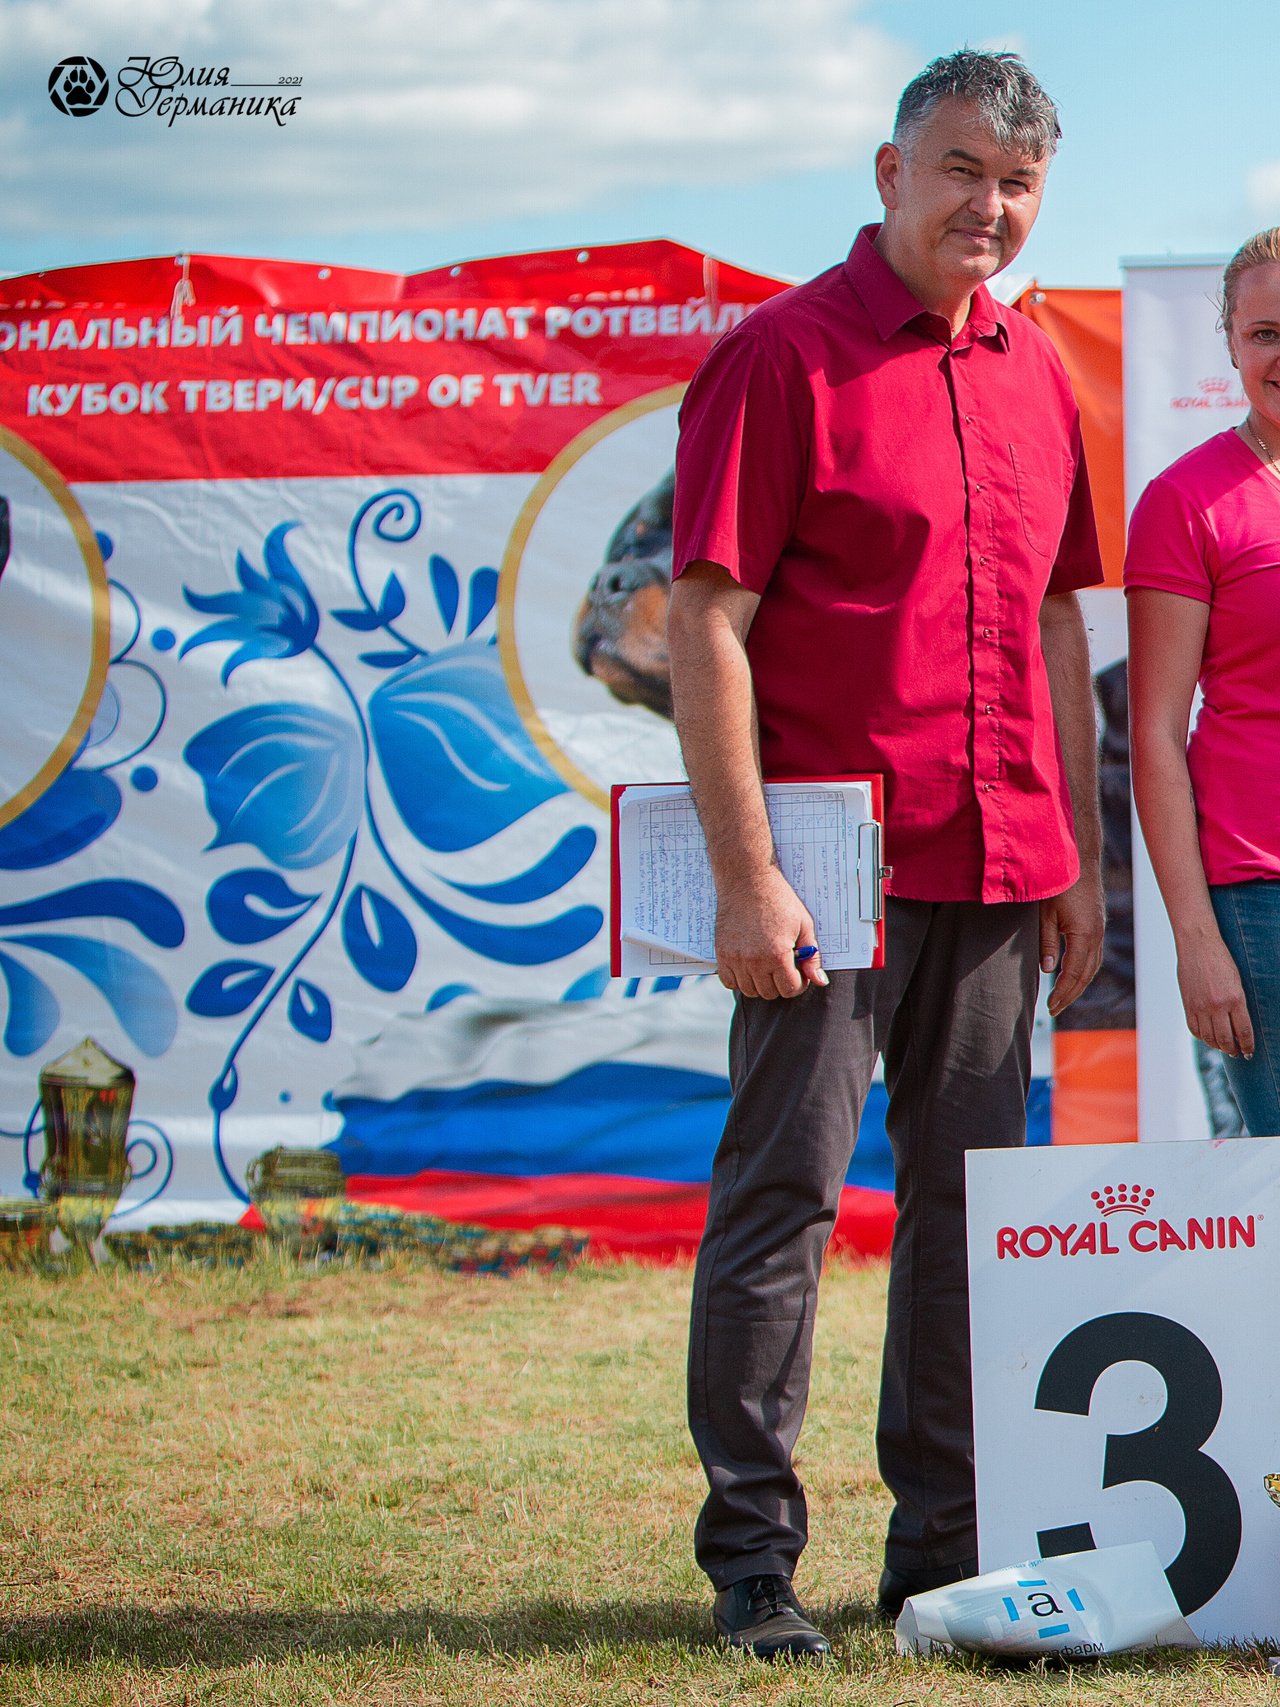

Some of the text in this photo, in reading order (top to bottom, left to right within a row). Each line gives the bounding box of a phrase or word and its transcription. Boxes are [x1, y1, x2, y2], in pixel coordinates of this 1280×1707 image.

[254, 307, 536, 346] ЧЕМПИОНАТ
[544, 295, 760, 340] РОТВЕЙЛ
[27, 372, 603, 417] КУБОК ТВЕРИ/CUP OF TVER
[997, 1215, 1256, 1260] ROYAL CANIN
[1033, 1311, 1243, 1622] 3
